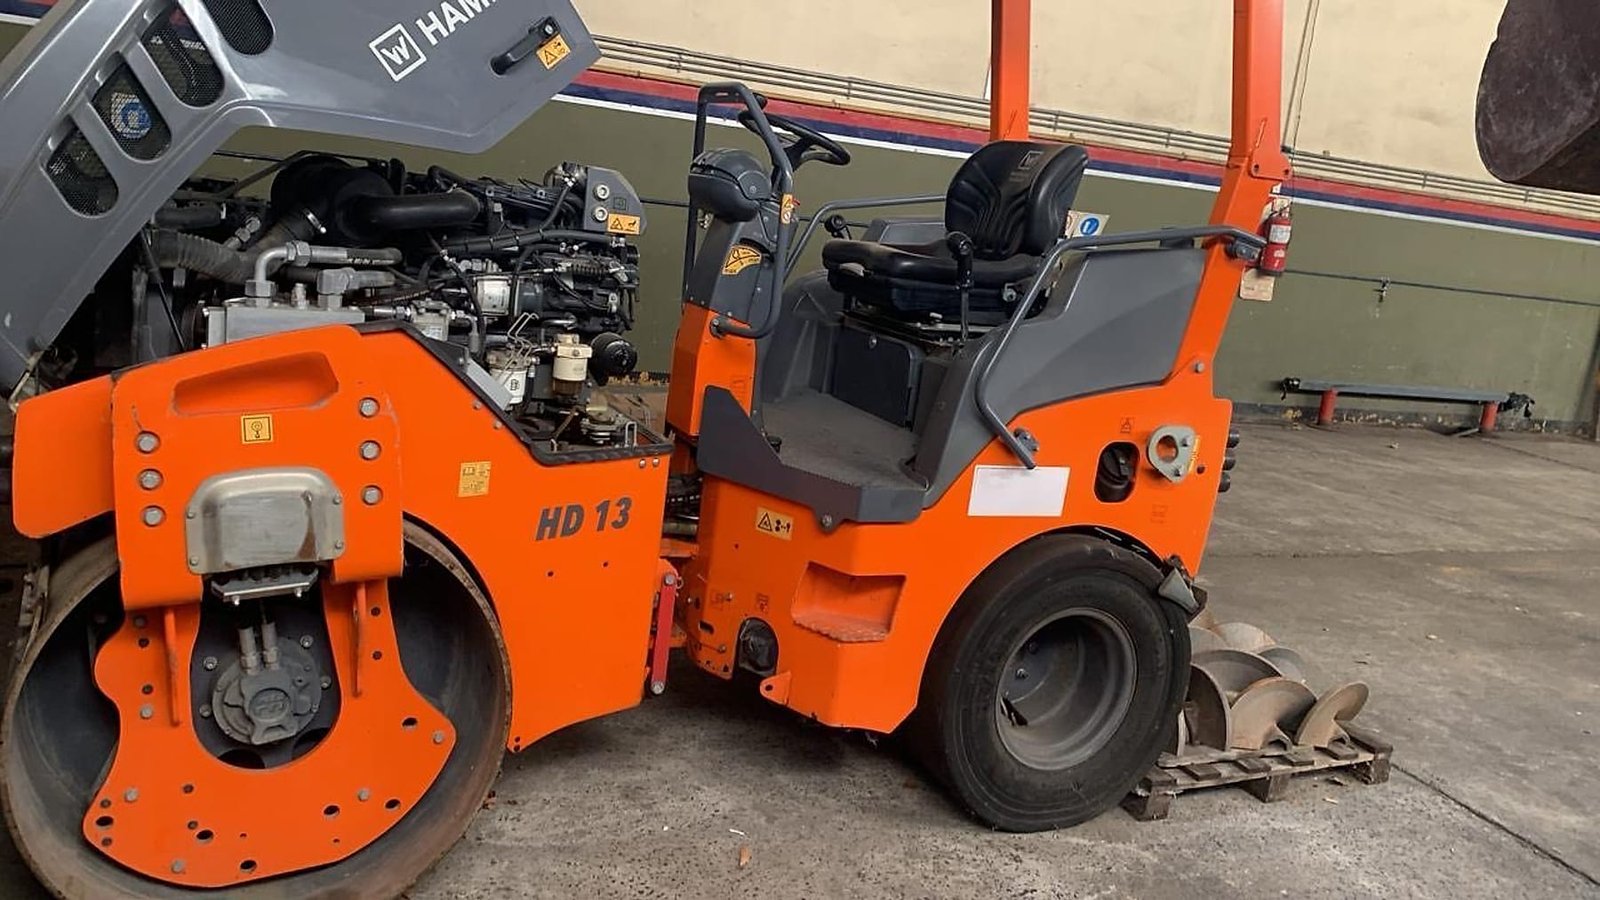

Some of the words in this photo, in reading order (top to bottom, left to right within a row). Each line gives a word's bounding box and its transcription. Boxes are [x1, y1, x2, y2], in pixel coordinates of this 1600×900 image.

[415, 0, 497, 45] HAM
[535, 504, 585, 541] HD
[595, 497, 632, 531] 13
